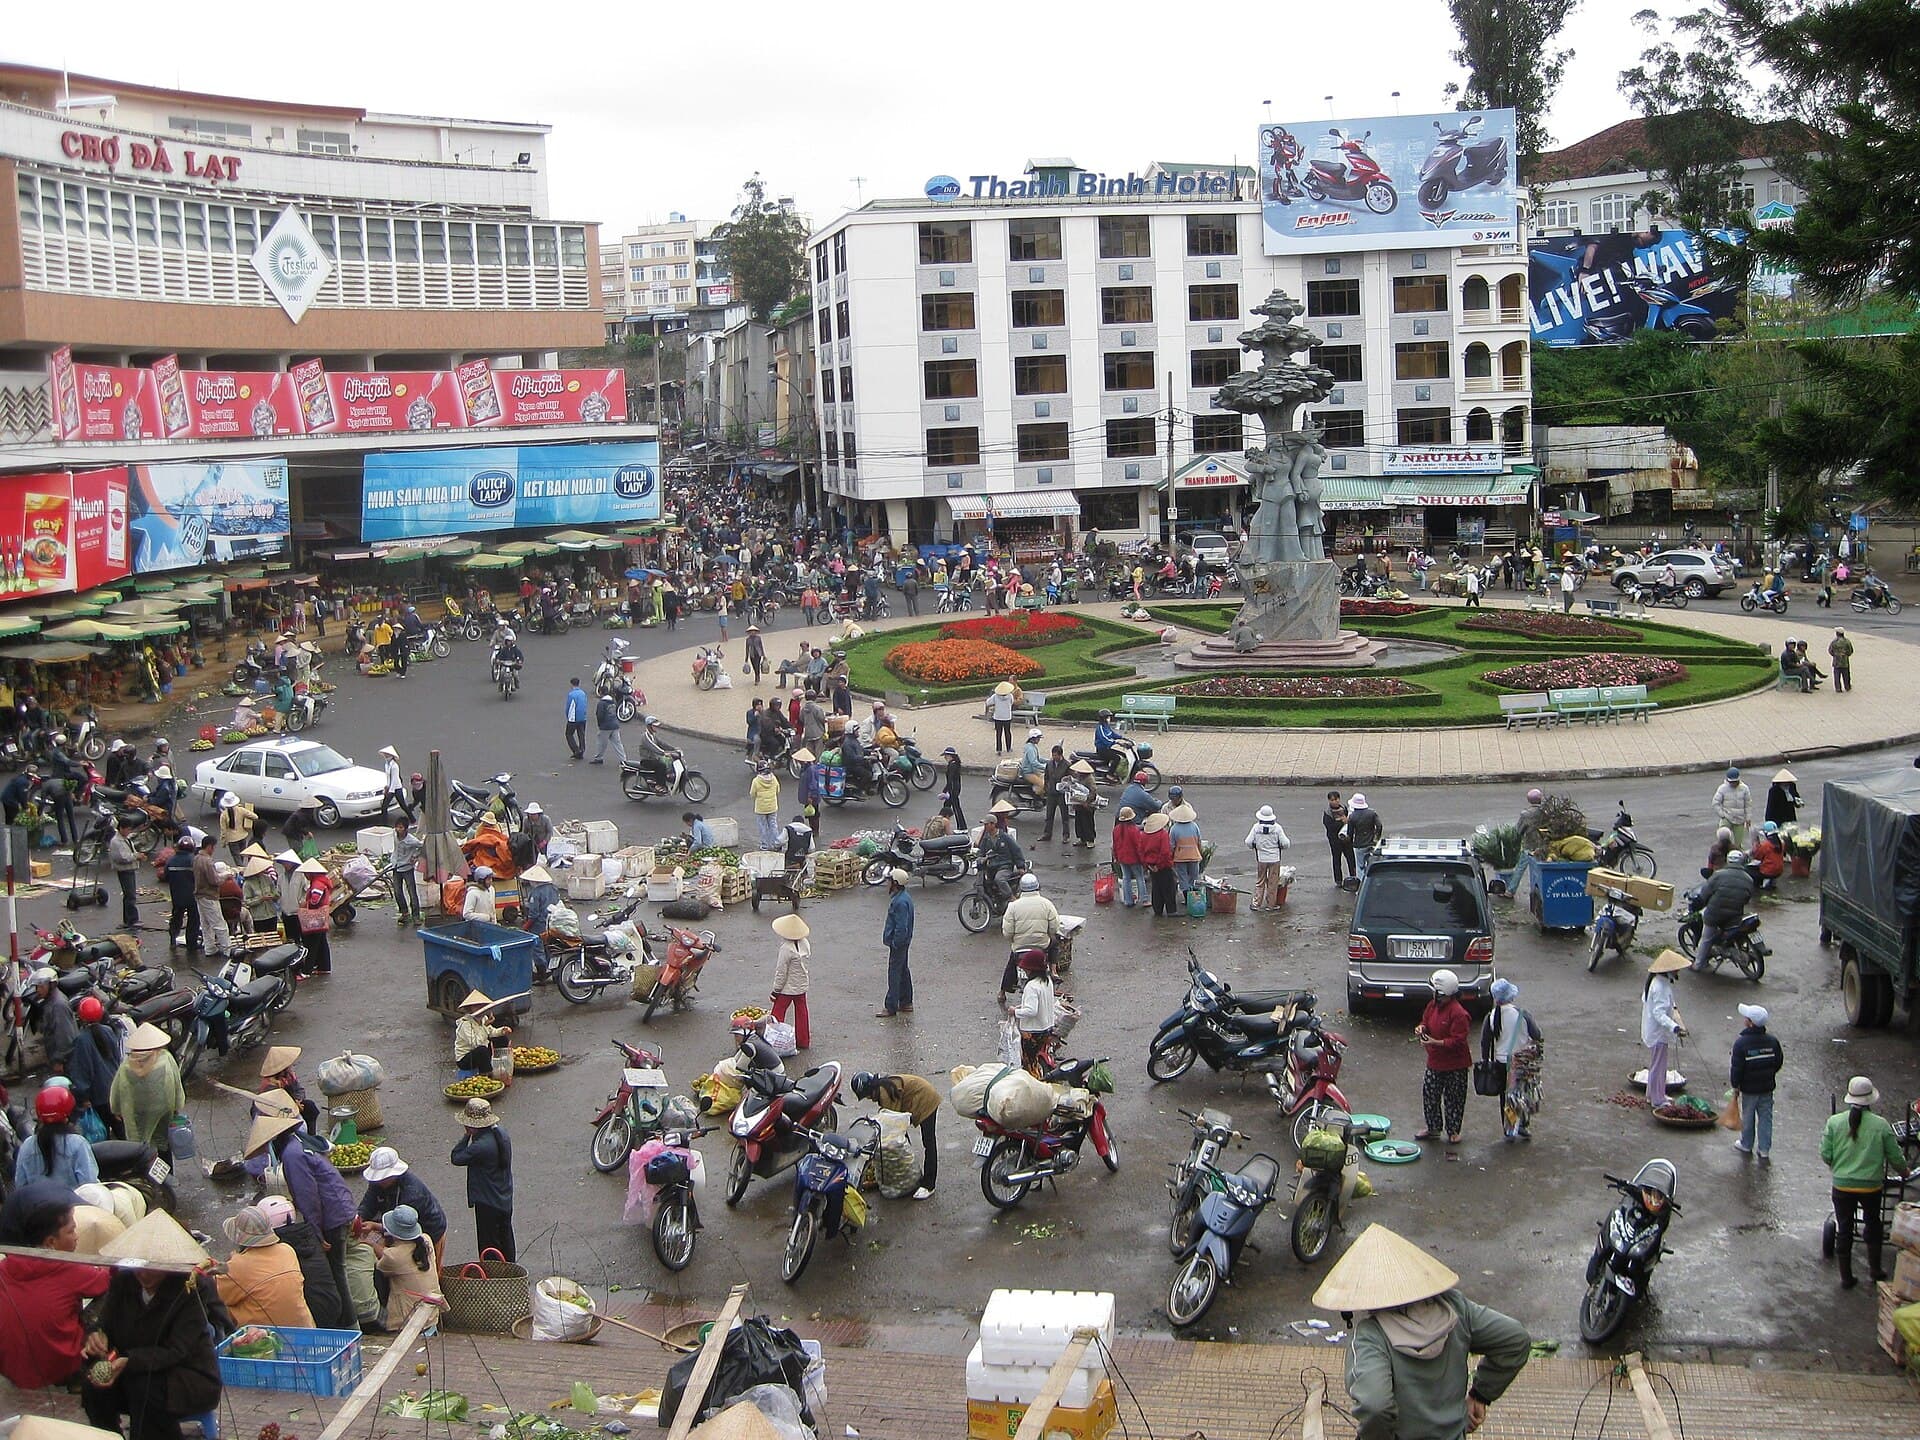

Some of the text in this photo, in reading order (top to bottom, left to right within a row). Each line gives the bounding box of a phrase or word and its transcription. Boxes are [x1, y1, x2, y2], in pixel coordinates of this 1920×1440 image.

[61, 130, 242, 185] CHỢ ĐÀ LẠT
[969, 170, 1237, 200] Thanh Bình Hotel
[1485, 231, 1511, 240] SYM
[281, 256, 319, 276] Festival
[1528, 267, 1621, 334] LIVE!
[196, 377, 237, 405] Aji-ngon
[344, 377, 392, 403] Aji-ngon
[512, 375, 564, 399] Aji-ngon
[477, 477, 507, 491] DUTCH
[621, 470, 647, 483] DUTCH
[623, 481, 645, 493] LADY
[1184, 477, 1205, 486] THANH
[1220, 474, 1238, 484] HOTEL
[367, 484, 463, 510] MUA SAM NUA DI
[479, 489, 502, 503] LADY
[523, 477, 607, 498] KET BAN NUA DI
[75, 496, 105, 522] Miwon
[1409, 950, 1430, 958] 7021
